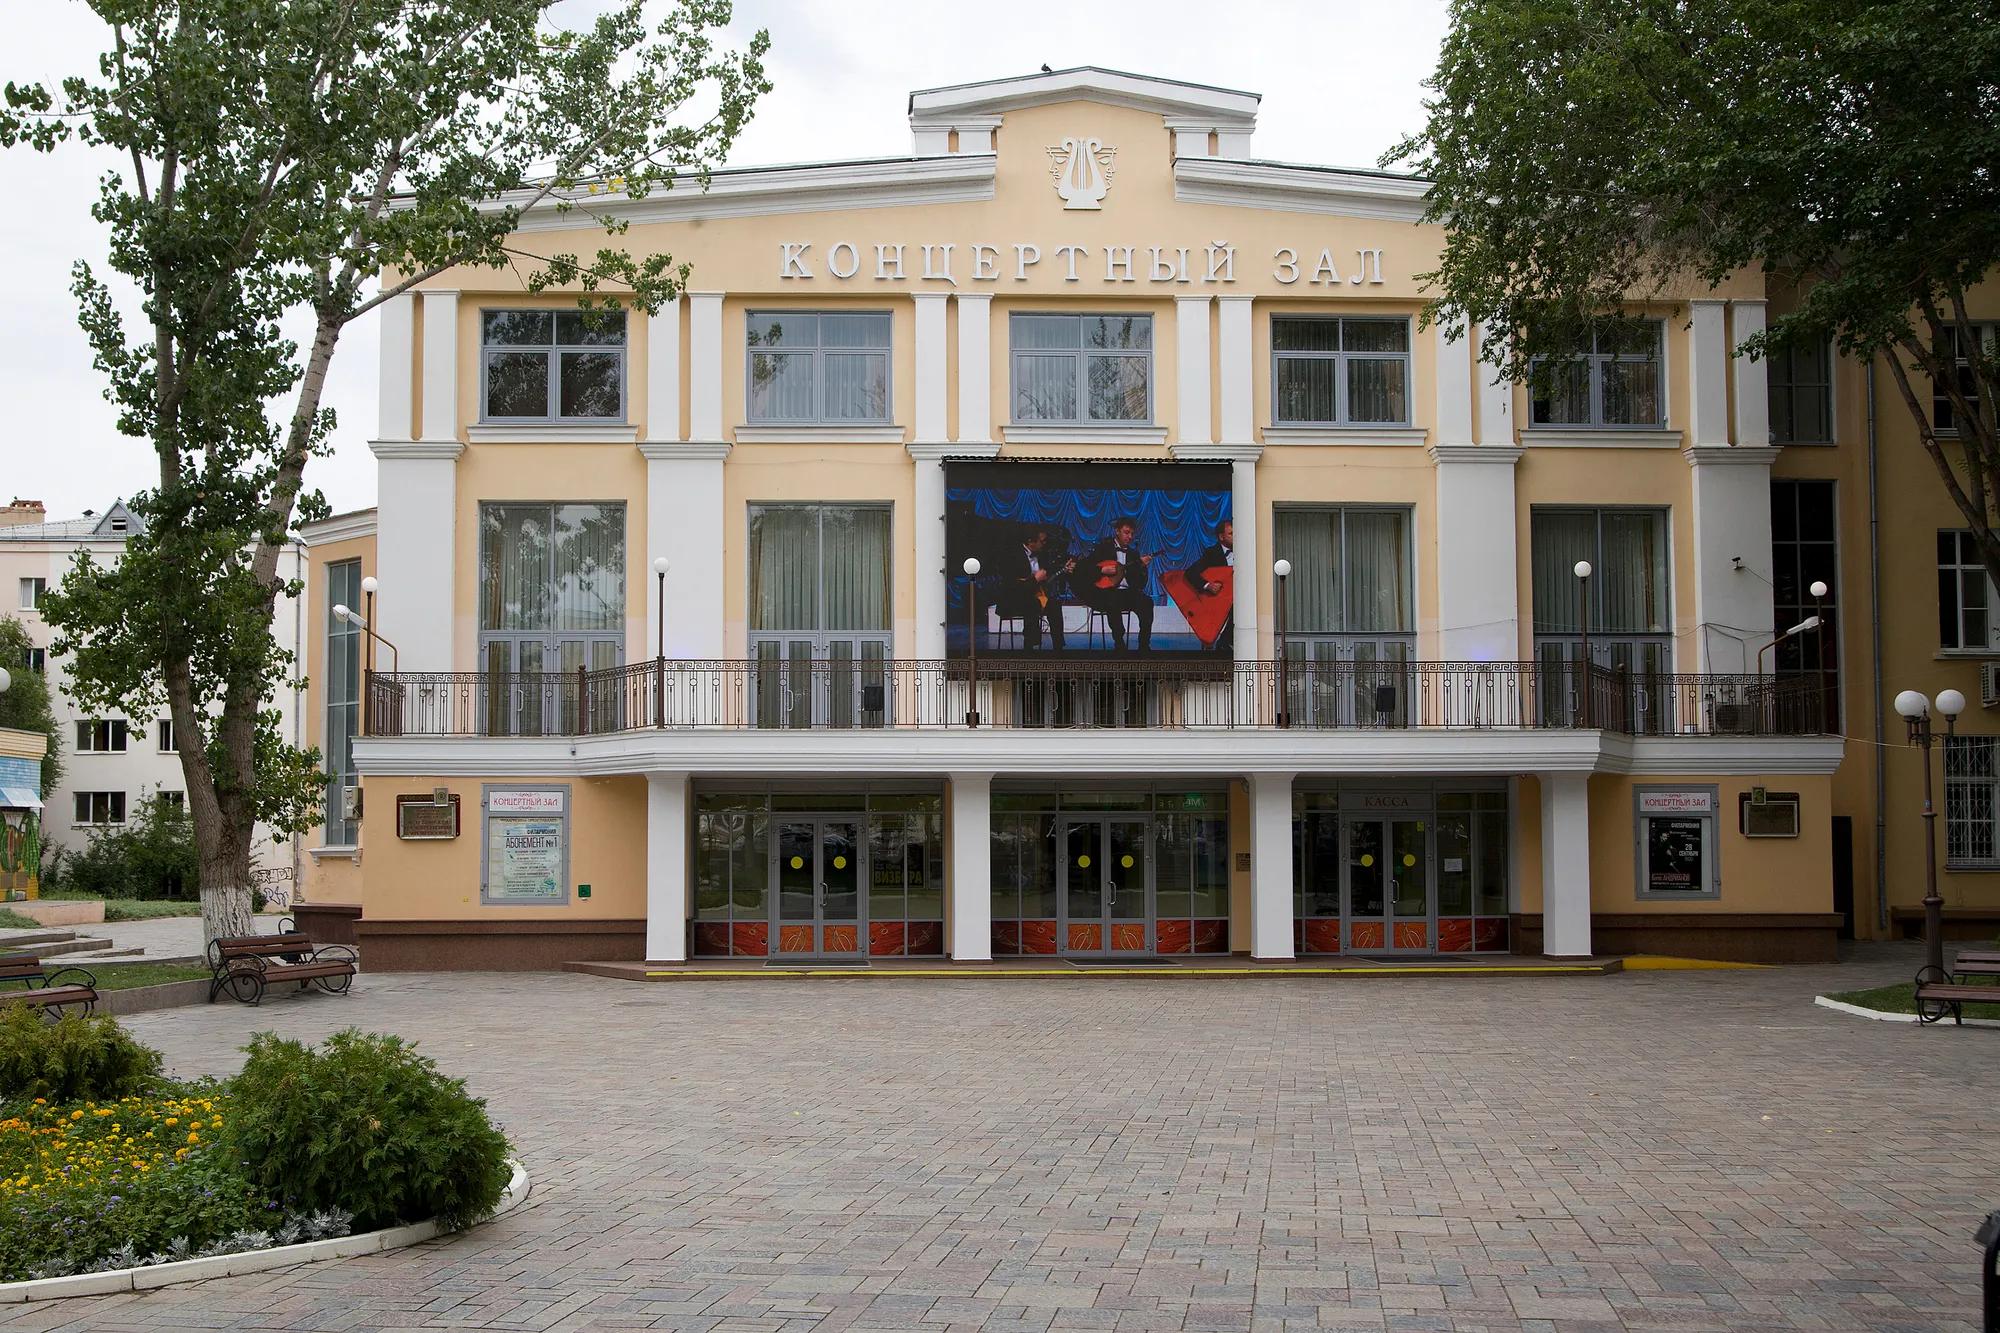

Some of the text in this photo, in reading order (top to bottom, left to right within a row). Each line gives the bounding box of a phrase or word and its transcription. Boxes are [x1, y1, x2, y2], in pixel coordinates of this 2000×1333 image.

[779, 239, 1385, 287] КОНЦЕРТНЫЙ ЗАЛ
[493, 798, 558, 806] КОНЦЕРТНЫЙ ЗАЛ
[1365, 796, 1408, 807] КАССА
[1645, 798, 1690, 806] КОНЦЕРТНЫЙ
[506, 836, 544, 848] АБОНЕМЕНТ
[875, 871, 922, 884] ВИЗБРА
